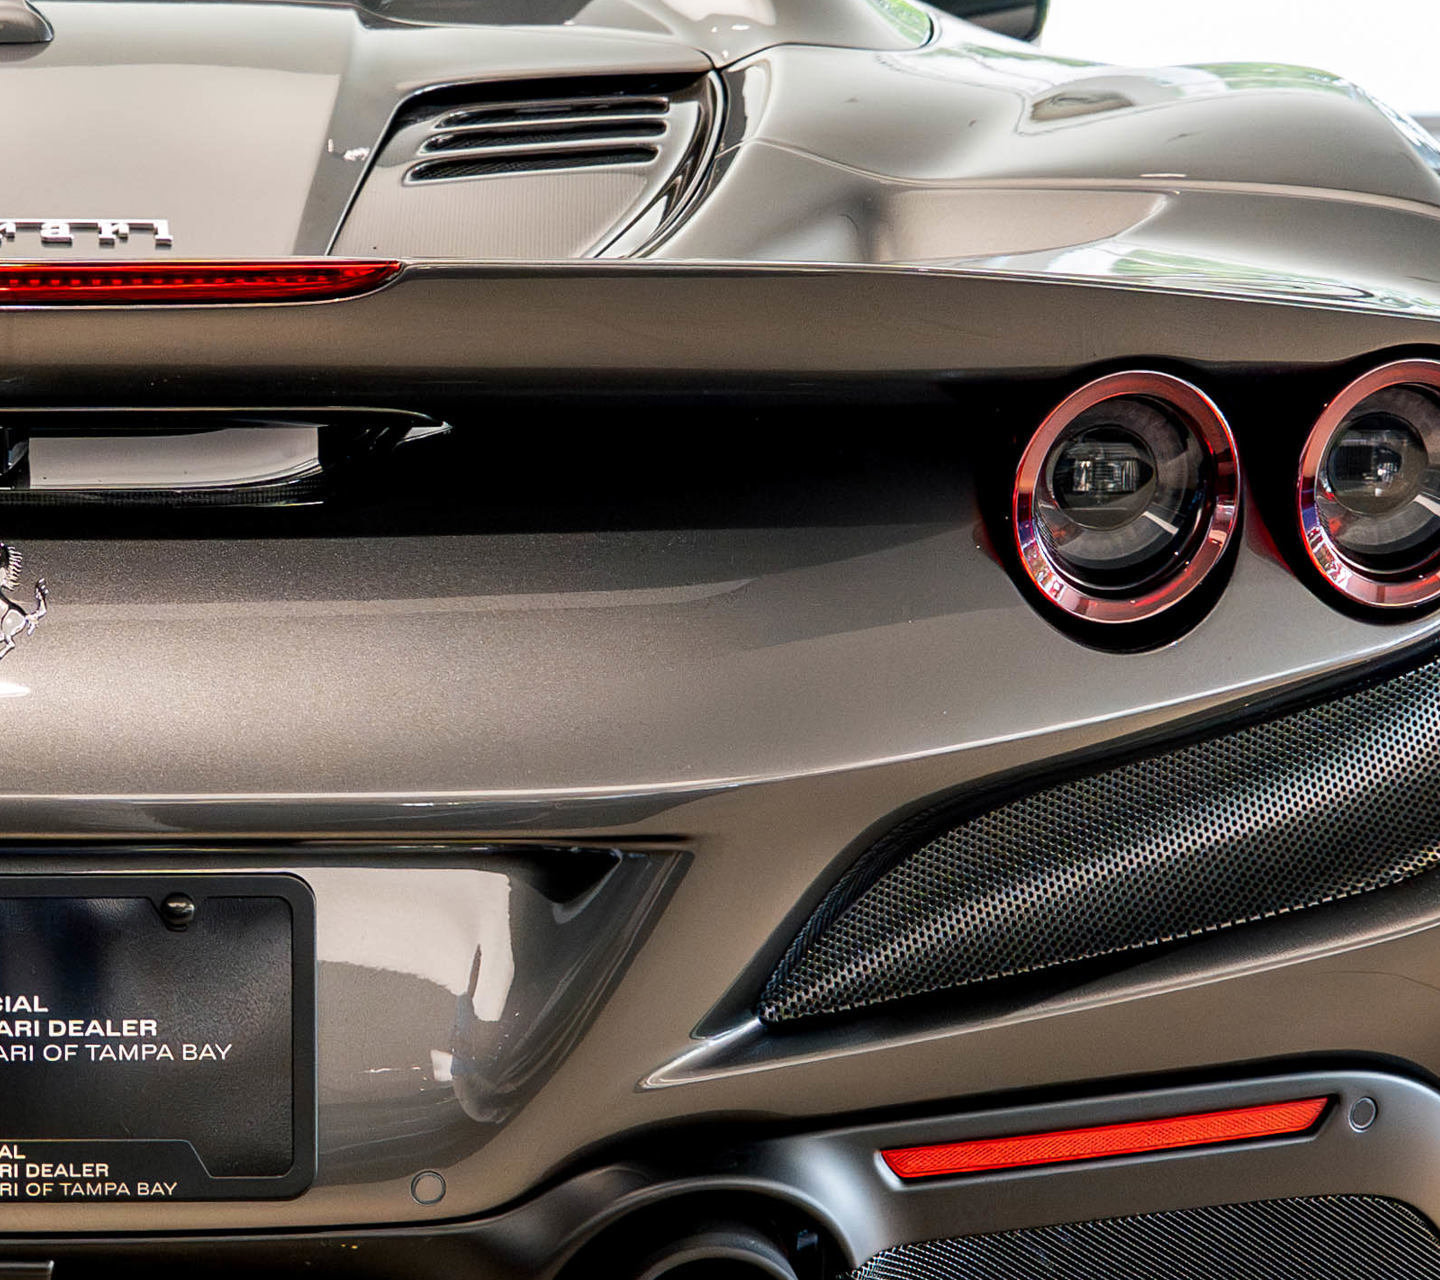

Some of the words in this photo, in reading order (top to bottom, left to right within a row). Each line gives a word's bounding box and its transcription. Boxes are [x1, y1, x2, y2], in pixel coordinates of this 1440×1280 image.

[48, 1018, 158, 1037] DEALER
[42, 1044, 79, 1062] OF
[85, 1043, 174, 1062] TAMPA
[183, 1042, 233, 1061] BAY
[25, 1162, 110, 1179] DEALER
[25, 1182, 55, 1197] OF
[58, 1182, 131, 1196] TAMPA
[137, 1181, 178, 1196] BAY
